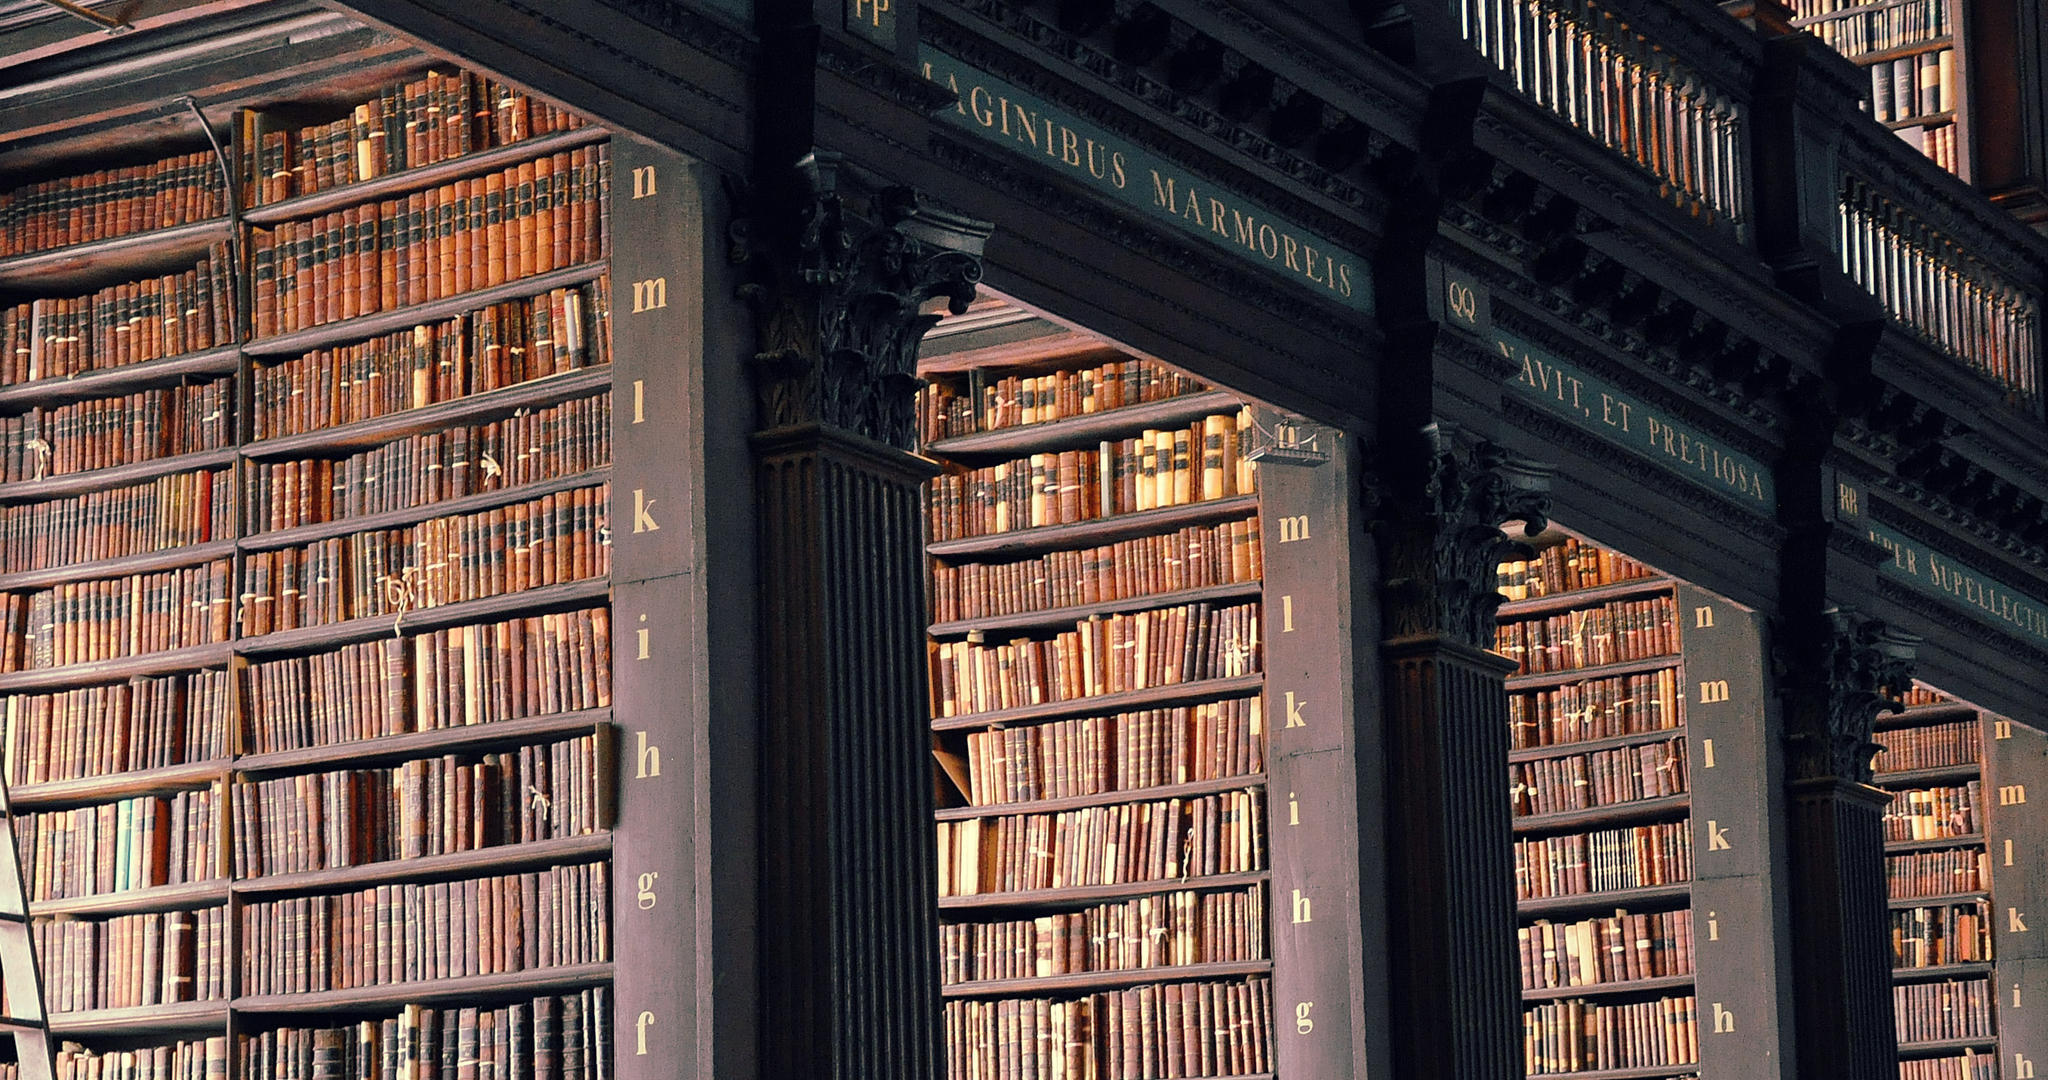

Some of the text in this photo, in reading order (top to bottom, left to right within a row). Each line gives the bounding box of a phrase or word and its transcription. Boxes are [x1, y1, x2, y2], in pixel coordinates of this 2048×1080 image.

[632, 166, 656, 199] n
[1150, 169, 1351, 297] MARMOREIS
[632, 278, 666, 313] m
[1450, 282, 1475, 323] QQ
[633, 380, 644, 423] l
[1601, 392, 1631, 432] ET
[1648, 416, 1763, 500] PRETIOSA
[633, 489, 660, 533] k
[1840, 483, 1858, 514] RR
[1279, 515, 1310, 543] m
[1282, 596, 1294, 632] l
[1696, 606, 1714, 628] n
[636, 614, 649, 660] i
[1700, 680, 1728, 703] m
[1285, 692, 1306, 728] k
[1994, 721, 2012, 740] n
[636, 731, 660, 778] h
[1703, 739, 1714, 768] l
[1289, 792, 1299, 825] i
[2000, 785, 2026, 805] m
[1708, 821, 1731, 851] k
[2004, 840, 2013, 866] l
[638, 872, 658, 909] g
[1292, 889, 1312, 925] h
[2008, 908, 2028, 932] k
[1708, 911, 1718, 940] i
[2013, 984, 2021, 1007] i
[636, 1011, 654, 1055] f
[1296, 1002, 1313, 1034] g
[1713, 1003, 1734, 1033] h
[2015, 1053, 2034, 1079] h
